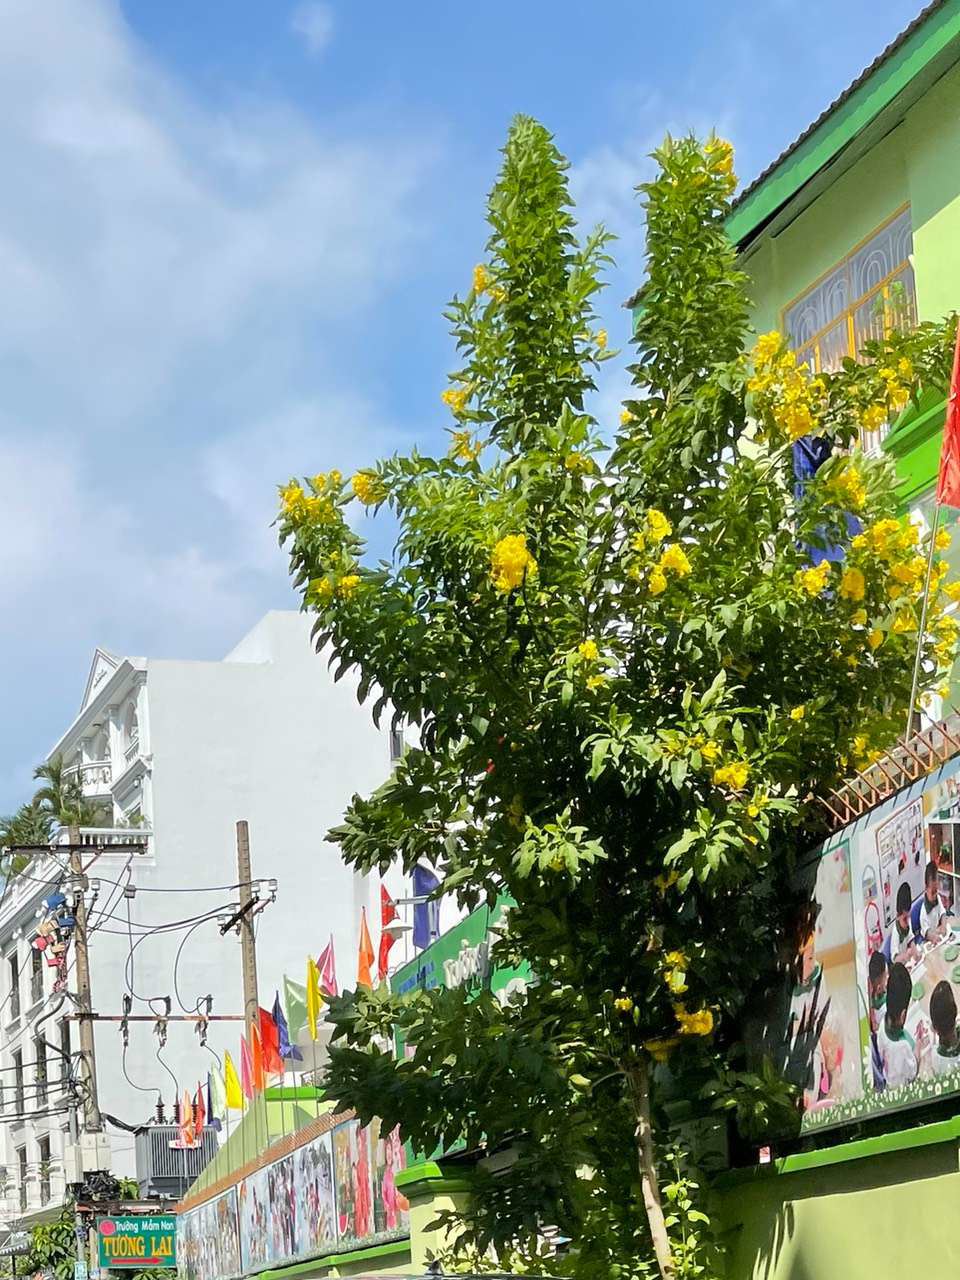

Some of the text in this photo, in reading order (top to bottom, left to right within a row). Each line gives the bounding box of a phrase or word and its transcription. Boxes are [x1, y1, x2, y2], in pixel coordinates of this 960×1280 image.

[161, 1220, 175, 1230] Non
[103, 1234, 173, 1256] TƯƠNG LAI
